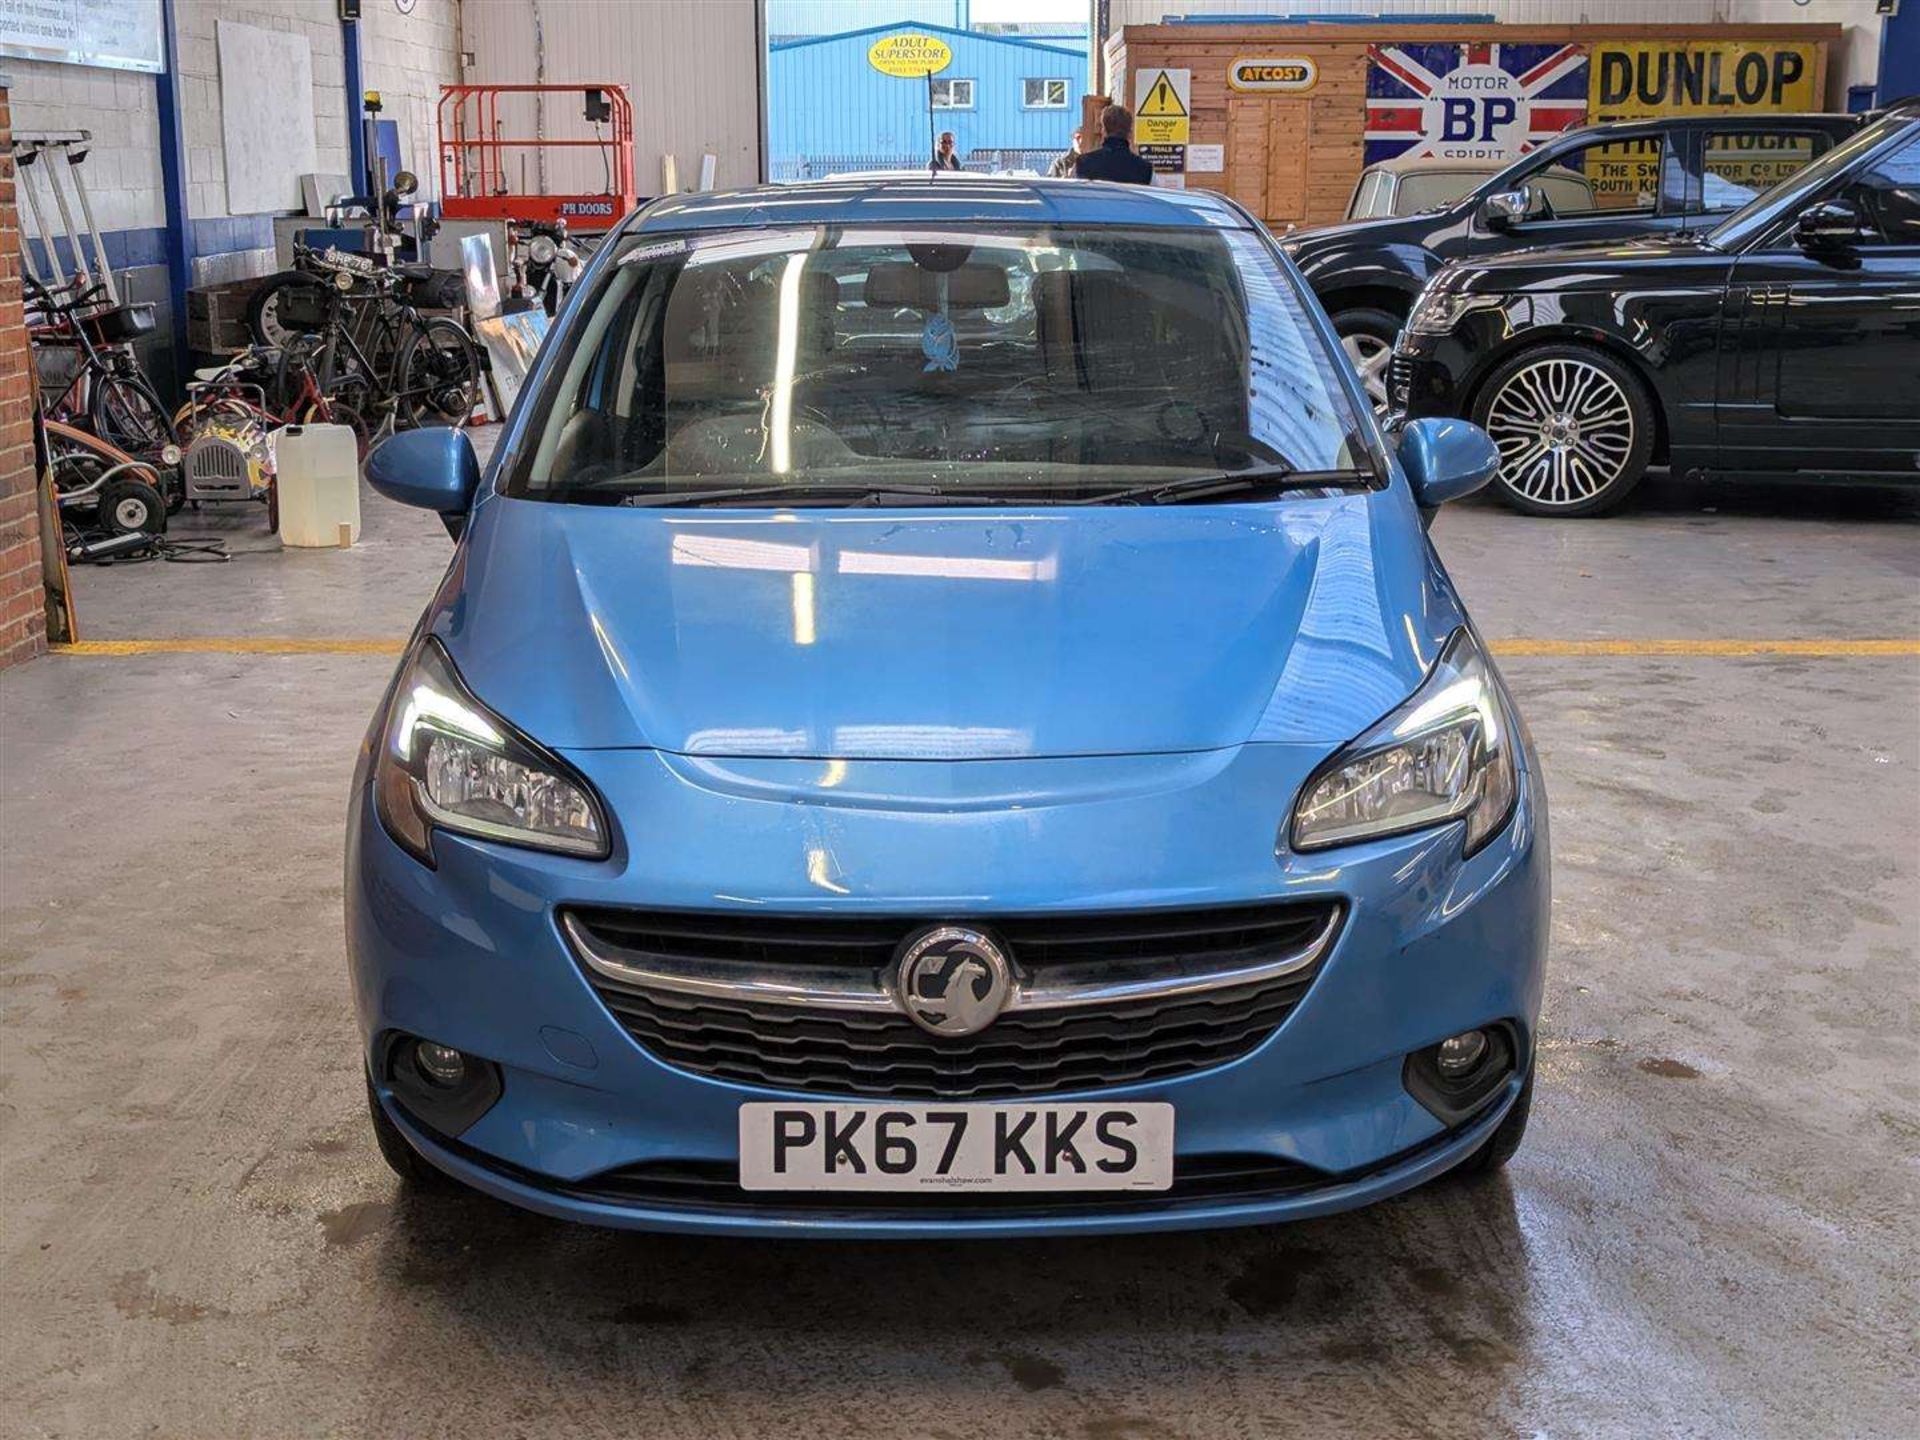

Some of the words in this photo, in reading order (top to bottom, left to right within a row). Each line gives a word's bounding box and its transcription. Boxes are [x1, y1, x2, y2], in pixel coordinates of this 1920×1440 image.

[891, 37, 928, 48] ADULT
[874, 48, 946, 59] SUPERSTORE
[1242, 67, 1303, 80] ATCOST
[1600, 51, 1804, 106] DUNLOP
[1448, 77, 1509, 89] MOTOR
[1147, 119, 1177, 129] Danger
[1601, 164, 1628, 177] THE
[1704, 164, 1742, 177] OTOR
[1591, 178, 1633, 192] SOUTH
[562, 203, 576, 214] PH
[579, 203, 613, 215] DOORS
[774, 1111, 968, 1174] PK67
[995, 1111, 1138, 1174] KKS
[920, 1176, 993, 1185] evanshalshaw.com
